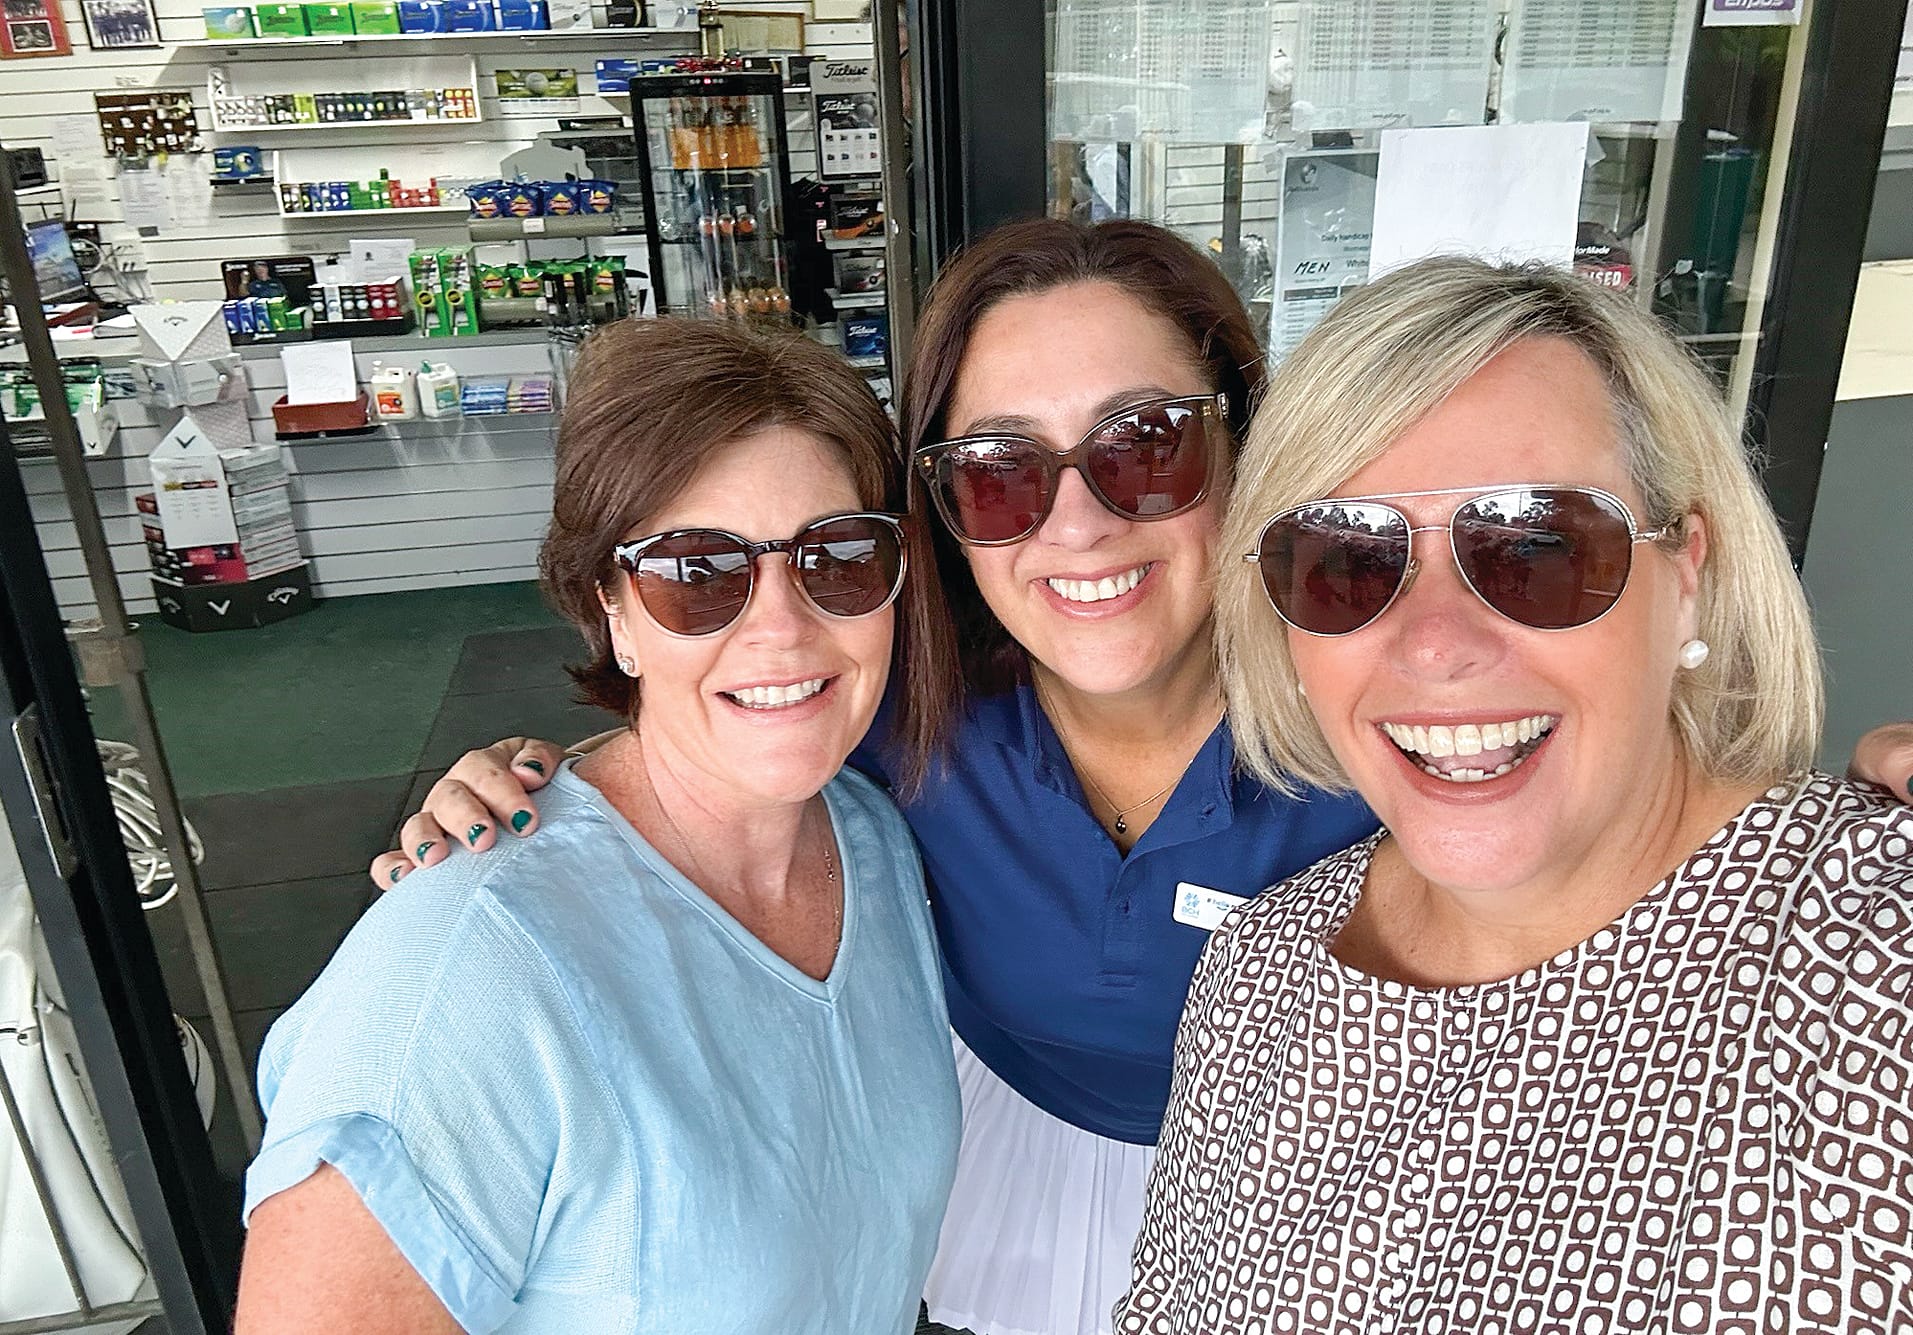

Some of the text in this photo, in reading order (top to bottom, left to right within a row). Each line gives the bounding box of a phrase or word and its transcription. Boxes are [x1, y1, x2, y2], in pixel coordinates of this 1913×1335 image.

[823, 63, 869, 78] Titleist
[1321, 233, 1338, 242] Daily
[1294, 261, 1330, 275] MEN
